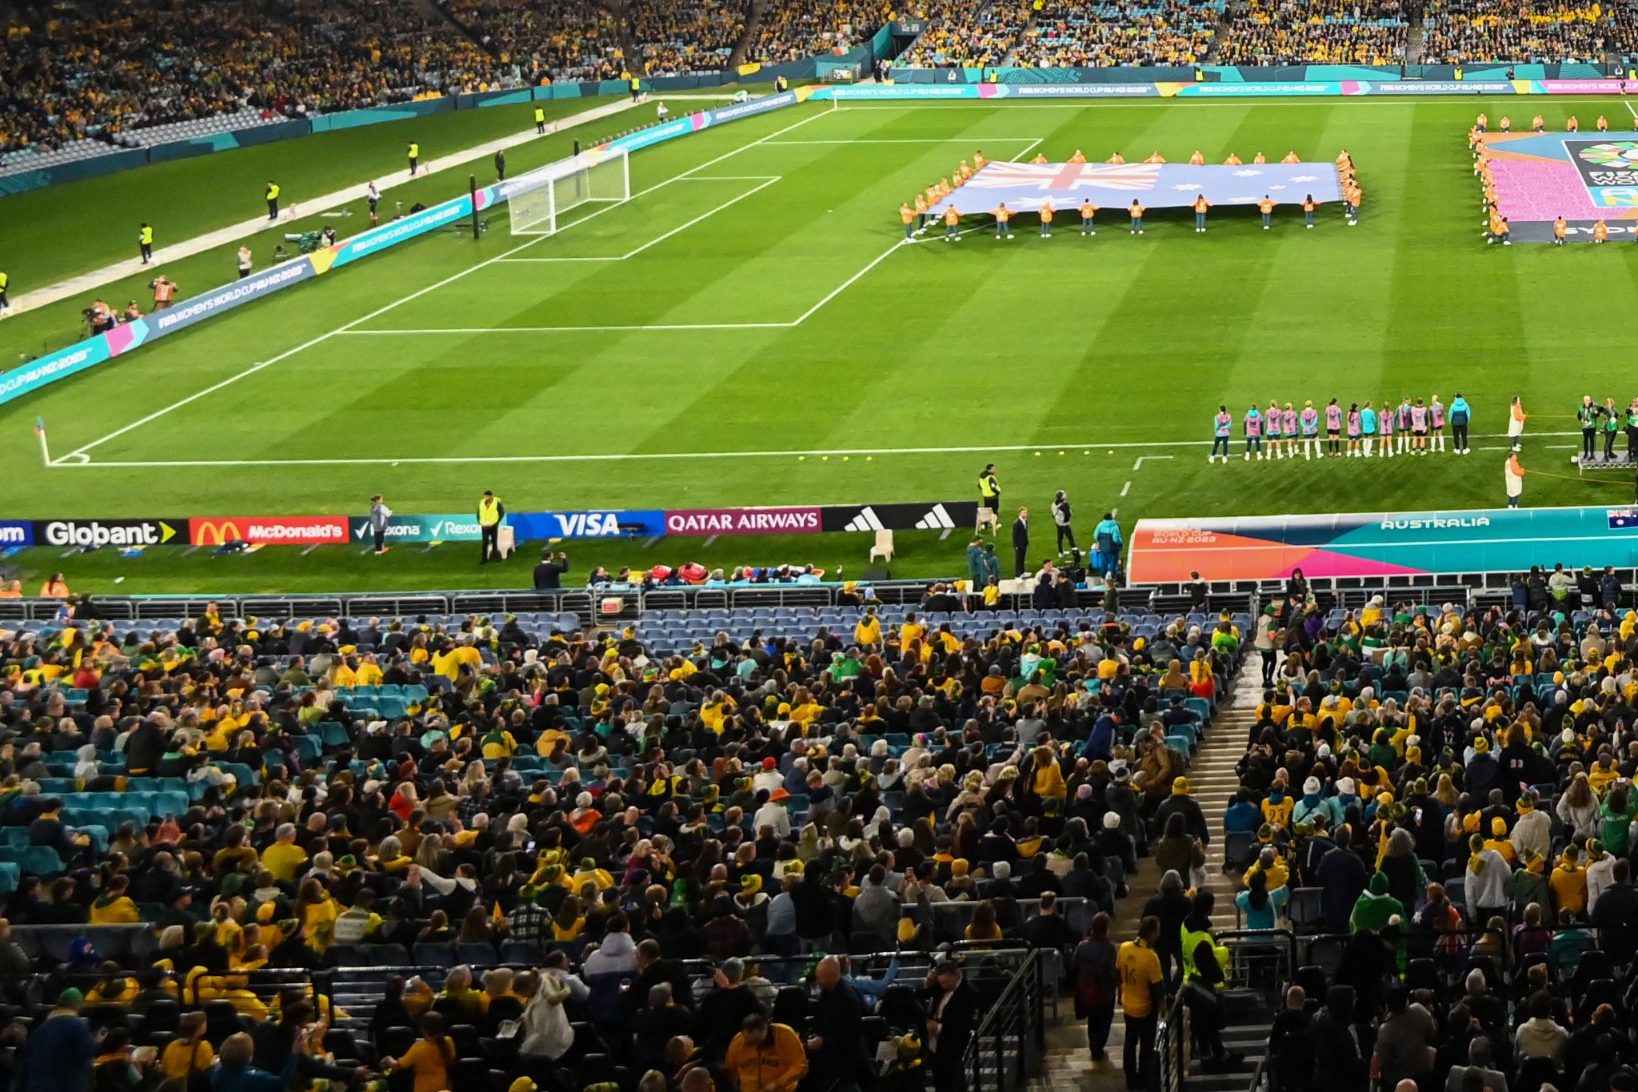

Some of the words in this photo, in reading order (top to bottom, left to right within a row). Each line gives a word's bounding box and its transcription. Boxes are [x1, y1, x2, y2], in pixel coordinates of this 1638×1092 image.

[6, 375, 26, 391] CUP
[444, 521, 482, 535] Rexo
[553, 514, 620, 535] VISA
[668, 514, 733, 531] QATAR
[738, 512, 818, 529] AIRWAYS
[1380, 516, 1490, 530] AUSTRALIA
[46, 521, 159, 545] Globant
[249, 523, 343, 539] McDonald's
